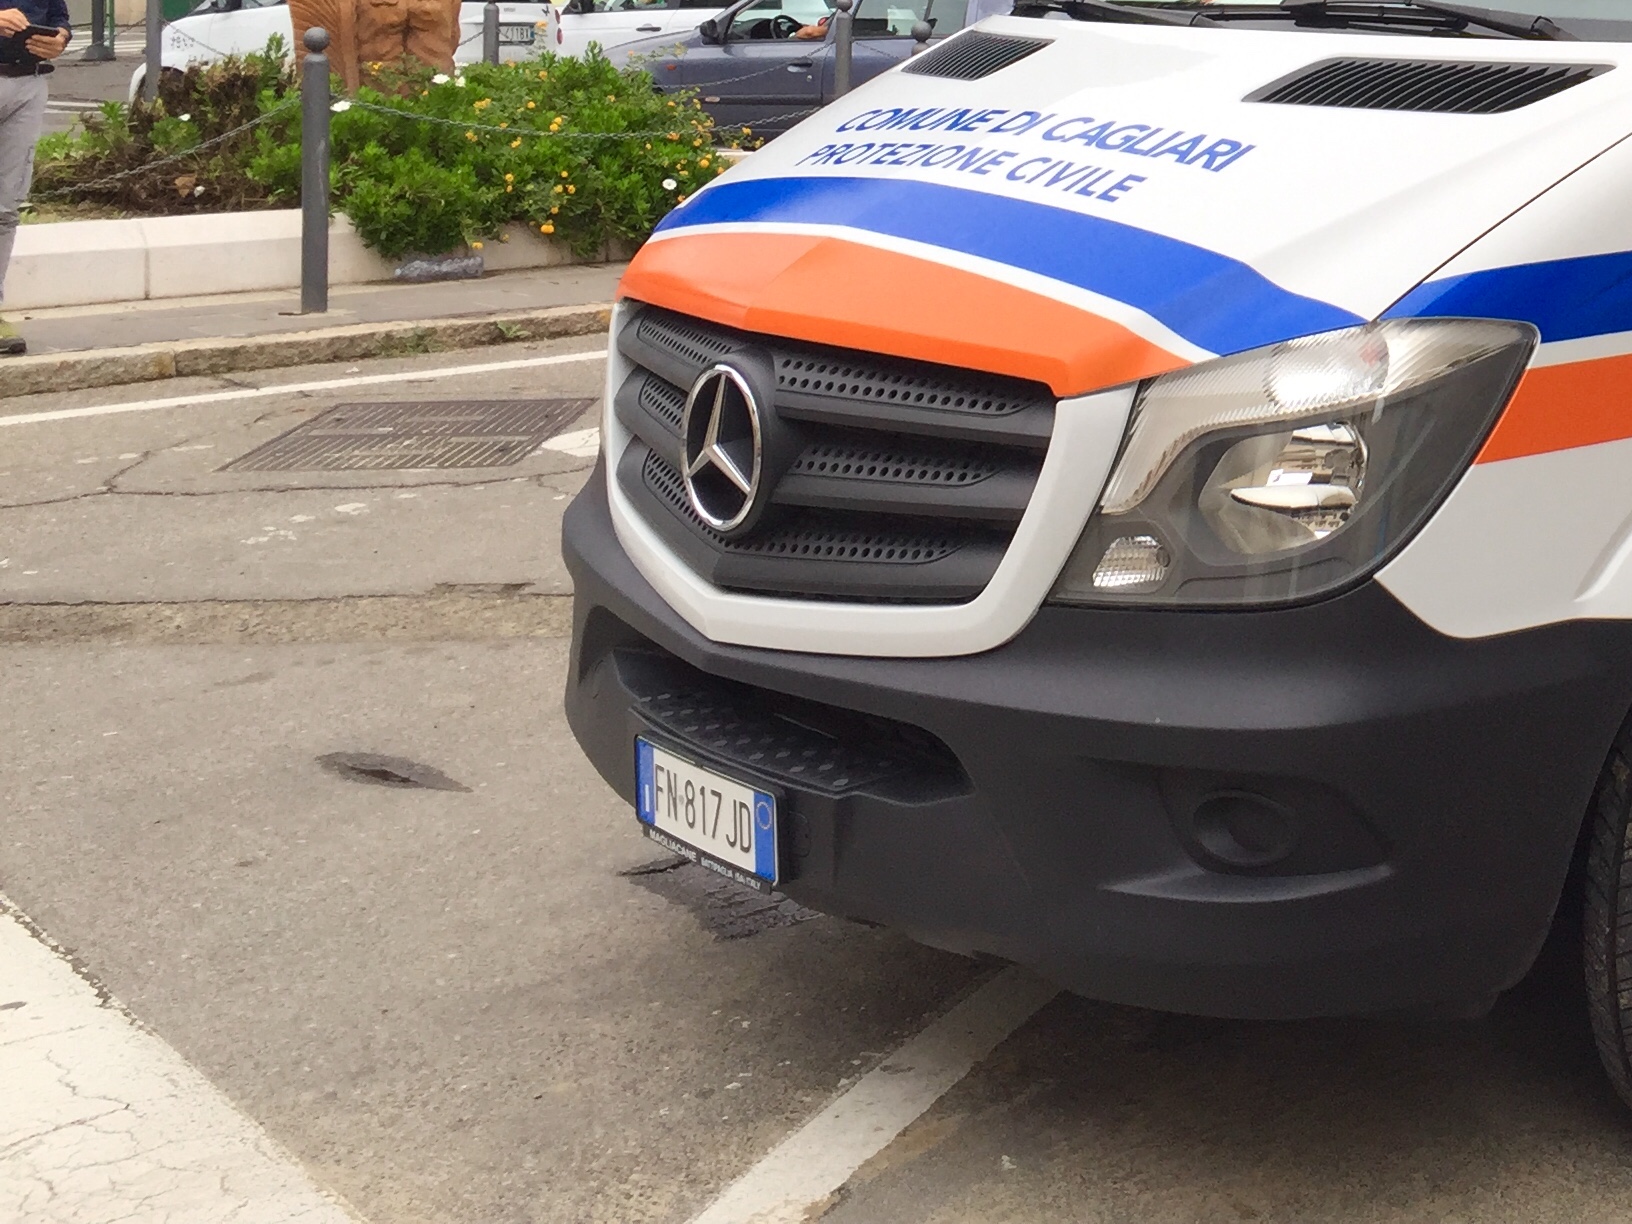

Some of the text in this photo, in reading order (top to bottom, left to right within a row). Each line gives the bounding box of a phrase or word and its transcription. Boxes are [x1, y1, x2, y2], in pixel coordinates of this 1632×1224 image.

[836, 107, 1257, 172] COMUNE DI CAGLIARI
[795, 143, 1149, 203] PROTEZIONE CIVILE
